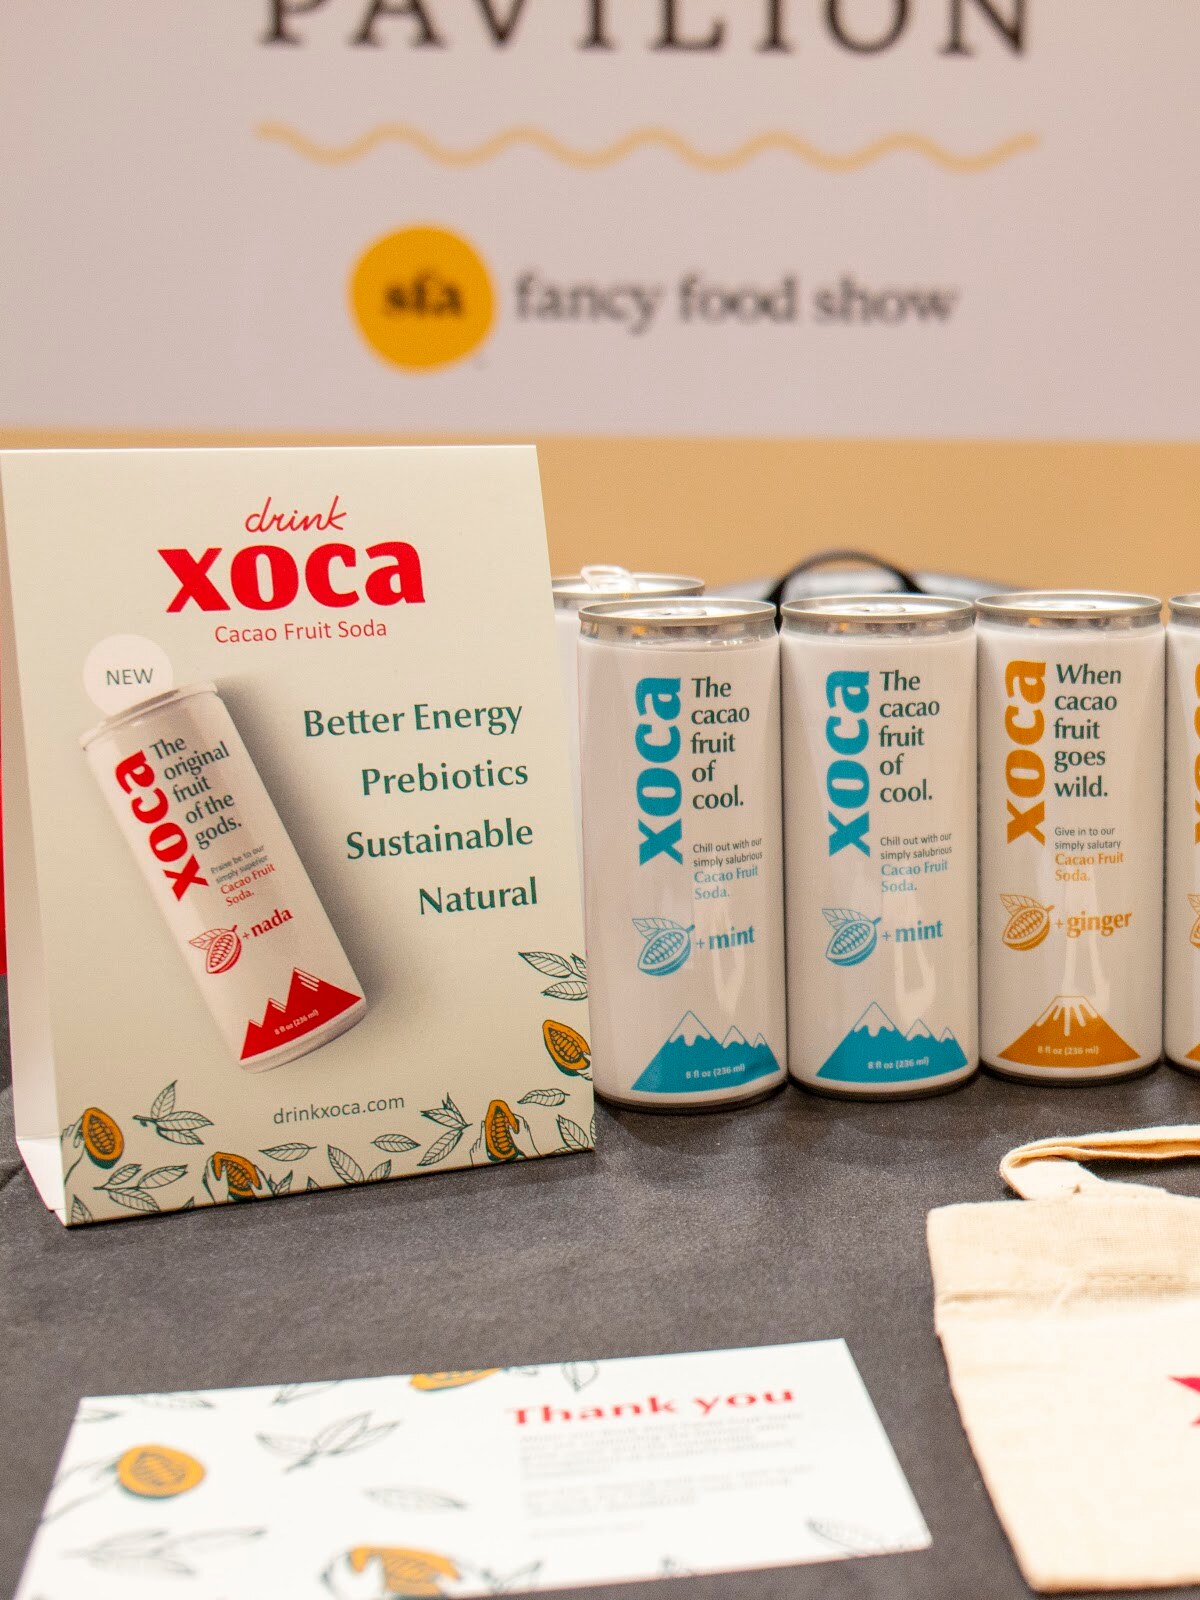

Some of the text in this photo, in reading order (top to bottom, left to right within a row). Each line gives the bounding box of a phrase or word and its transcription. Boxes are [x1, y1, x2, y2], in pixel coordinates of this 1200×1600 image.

[258, 0, 1029, 54] PAVILION
[381, 269, 958, 336] sfa fancy food show
[246, 496, 348, 532] drink
[158, 541, 426, 613] xoca
[214, 619, 388, 644] Cacao Fruit Soda
[105, 668, 154, 687] NEW
[879, 669, 921, 691] The
[1055, 663, 1122, 685] When
[691, 676, 732, 698] The
[879, 700, 940, 718] cacao
[1054, 693, 1118, 711] cacao
[303, 703, 523, 738] Better Energy
[691, 706, 750, 724] cacao
[879, 725, 925, 748] fruit
[1053, 717, 1100, 740] fruit
[149, 737, 187, 760] The
[690, 732, 736, 754] fruit
[1005, 660, 1046, 846] xoca
[163, 741, 230, 780] original
[635, 677, 683, 866] xoca
[692, 760, 717, 782] of
[825, 670, 870, 857] xoca
[879, 753, 905, 776] of
[1054, 749, 1106, 773] goes
[172, 775, 212, 802] fruit
[361, 760, 529, 796] Prebiotics
[1054, 775, 1108, 798] wild.
[692, 785, 744, 810] cool.
[880, 779, 933, 803] cool.
[185, 793, 235, 824] of the
[115, 750, 209, 901] xoca
[195, 815, 242, 849] gods.
[1054, 827, 1115, 837] Give in to our
[346, 818, 534, 860] Sustainable
[693, 838, 762, 854] Chill out with our
[880, 832, 952, 847] Chill out with our
[1054, 839, 1122, 851] simply salutary
[693, 851, 763, 867] simply salubrious
[880, 846, 952, 861] simply salubrious
[1055, 851, 1124, 865] Cacao Fruit
[215, 855, 269, 884] simply superior
[694, 865, 758, 883] Cacao Fruit
[881, 859, 948, 876] Cacao Fruit
[1055, 869, 1090, 882] Soda.
[220, 863, 276, 896] Cacao Fruit
[881, 879, 917, 893] Soda.
[225, 889, 255, 907] Soda.
[419, 877, 538, 915] Natural
[694, 886, 730, 900] Soda.
[250, 907, 294, 938] nada
[895, 920, 943, 943] mint
[1066, 910, 1132, 938] ginger
[708, 924, 755, 950] mint
[1037, 1046, 1043, 1054] 8
[1045, 1046, 1051, 1054] fl
[1064, 1046, 1083, 1056] (236
[685, 1070, 692, 1079] 8
[693, 1069, 700, 1078] fl
[701, 1070, 711, 1078] oz
[713, 1066, 731, 1077] (236
[867, 1061, 874, 1070] 8
[875, 1060, 882, 1069] fl
[895, 1060, 914, 1070] (236
[273, 1096, 405, 1124] drinkxoca.com
[506, 1388, 794, 1425] Thank you
